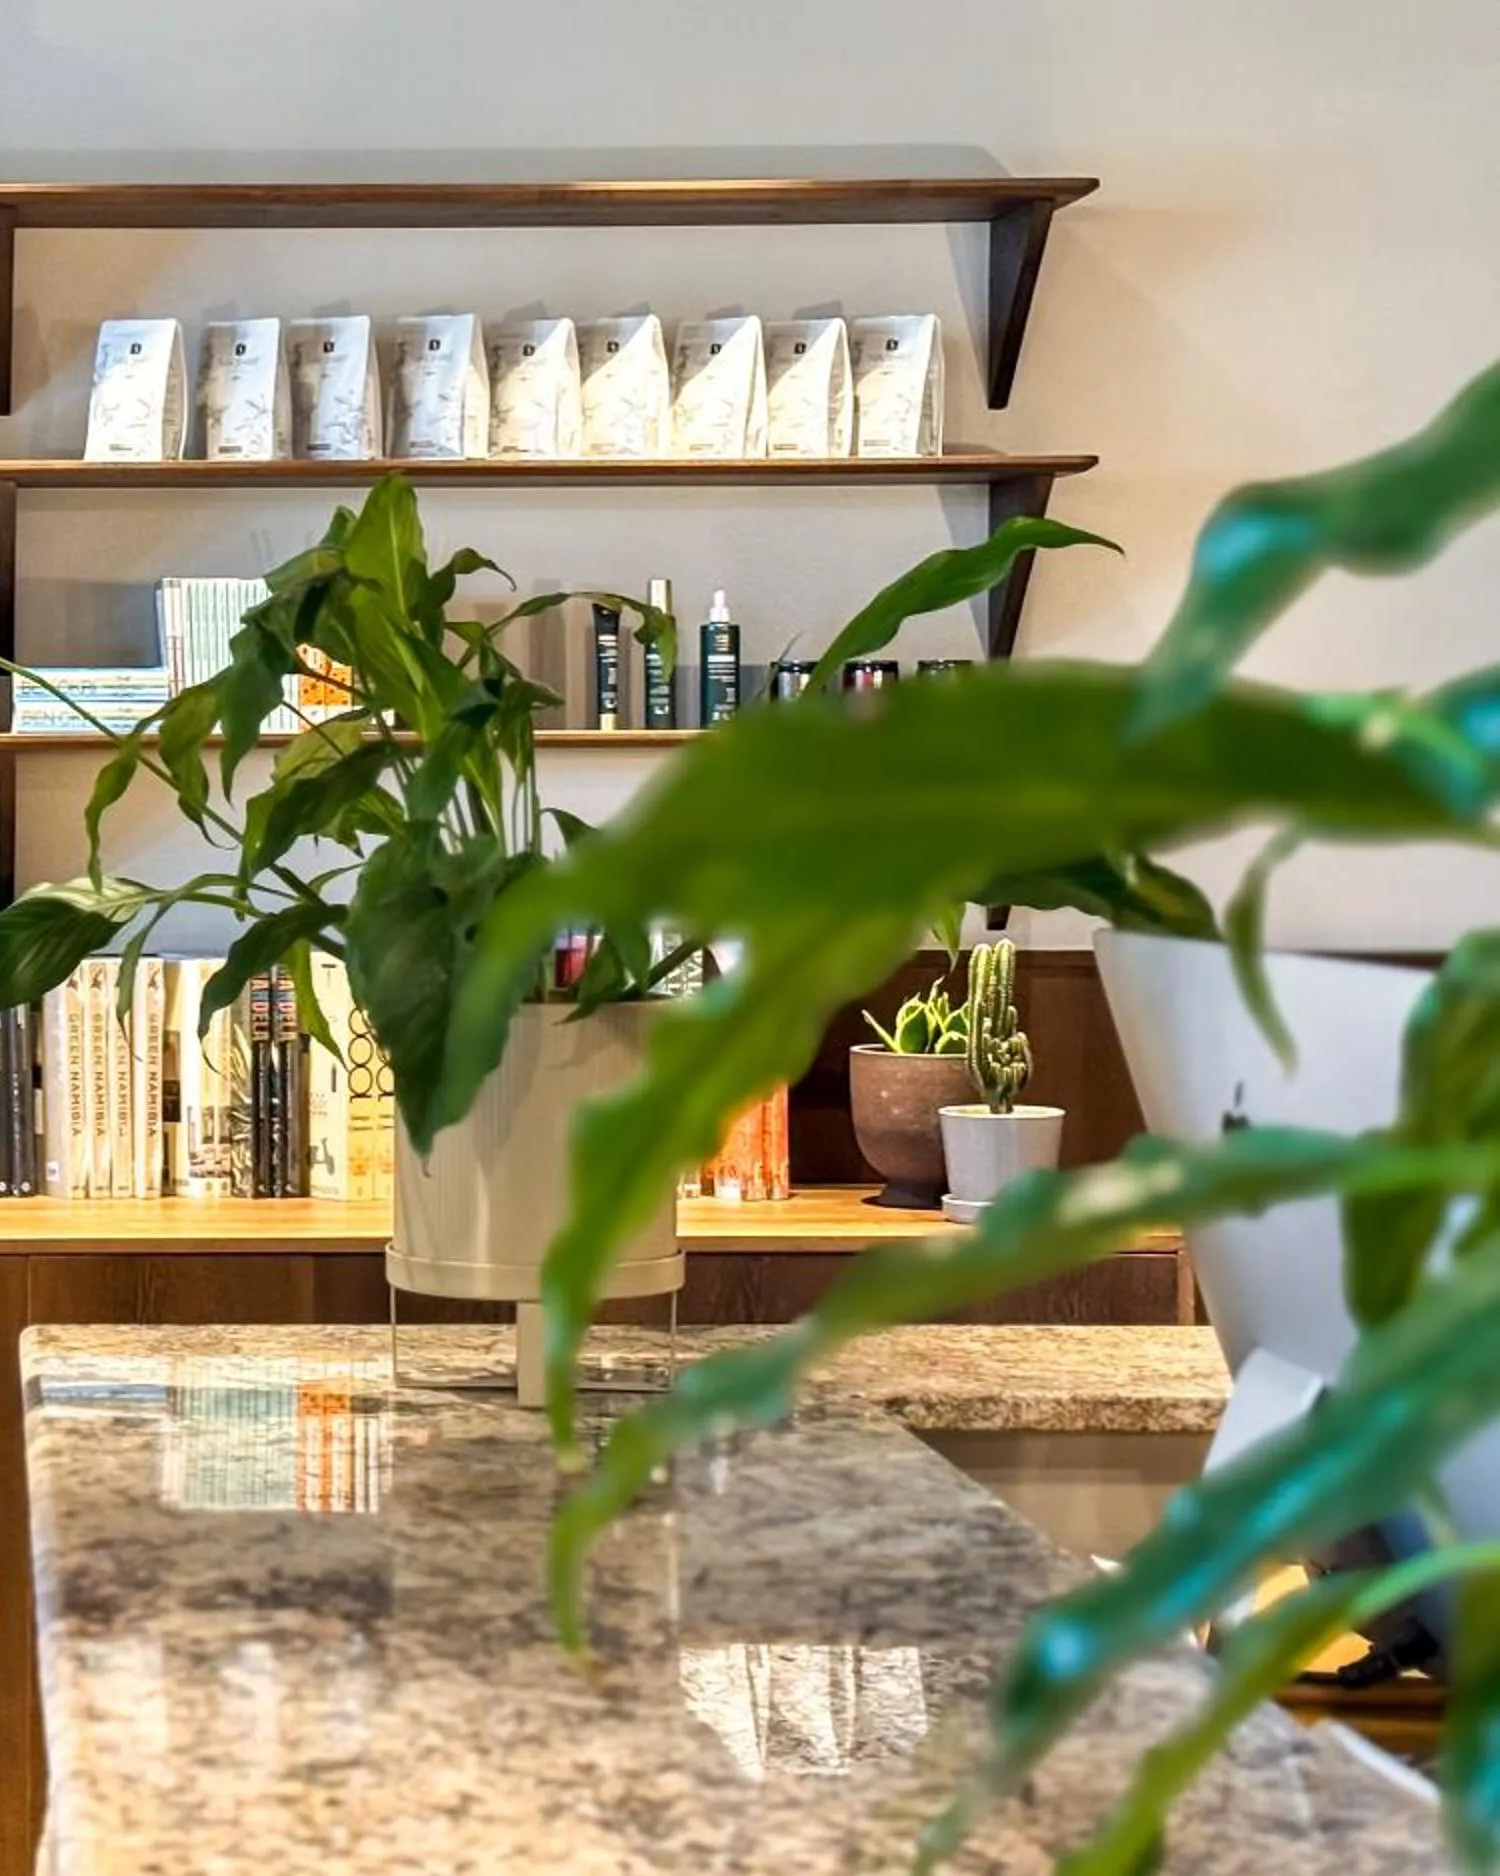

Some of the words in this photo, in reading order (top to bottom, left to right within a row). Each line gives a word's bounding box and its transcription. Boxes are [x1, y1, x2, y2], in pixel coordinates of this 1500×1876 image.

[69, 1013, 81, 1064] GREEN
[92, 1013, 103, 1064] GREEN
[149, 1013, 160, 1064] GREEN
[252, 974, 269, 1041] ANDELA
[70, 1072, 83, 1136] NAMIBIA
[95, 1072, 107, 1136] NAMIBIA
[148, 1072, 159, 1137] NAMIBIA
